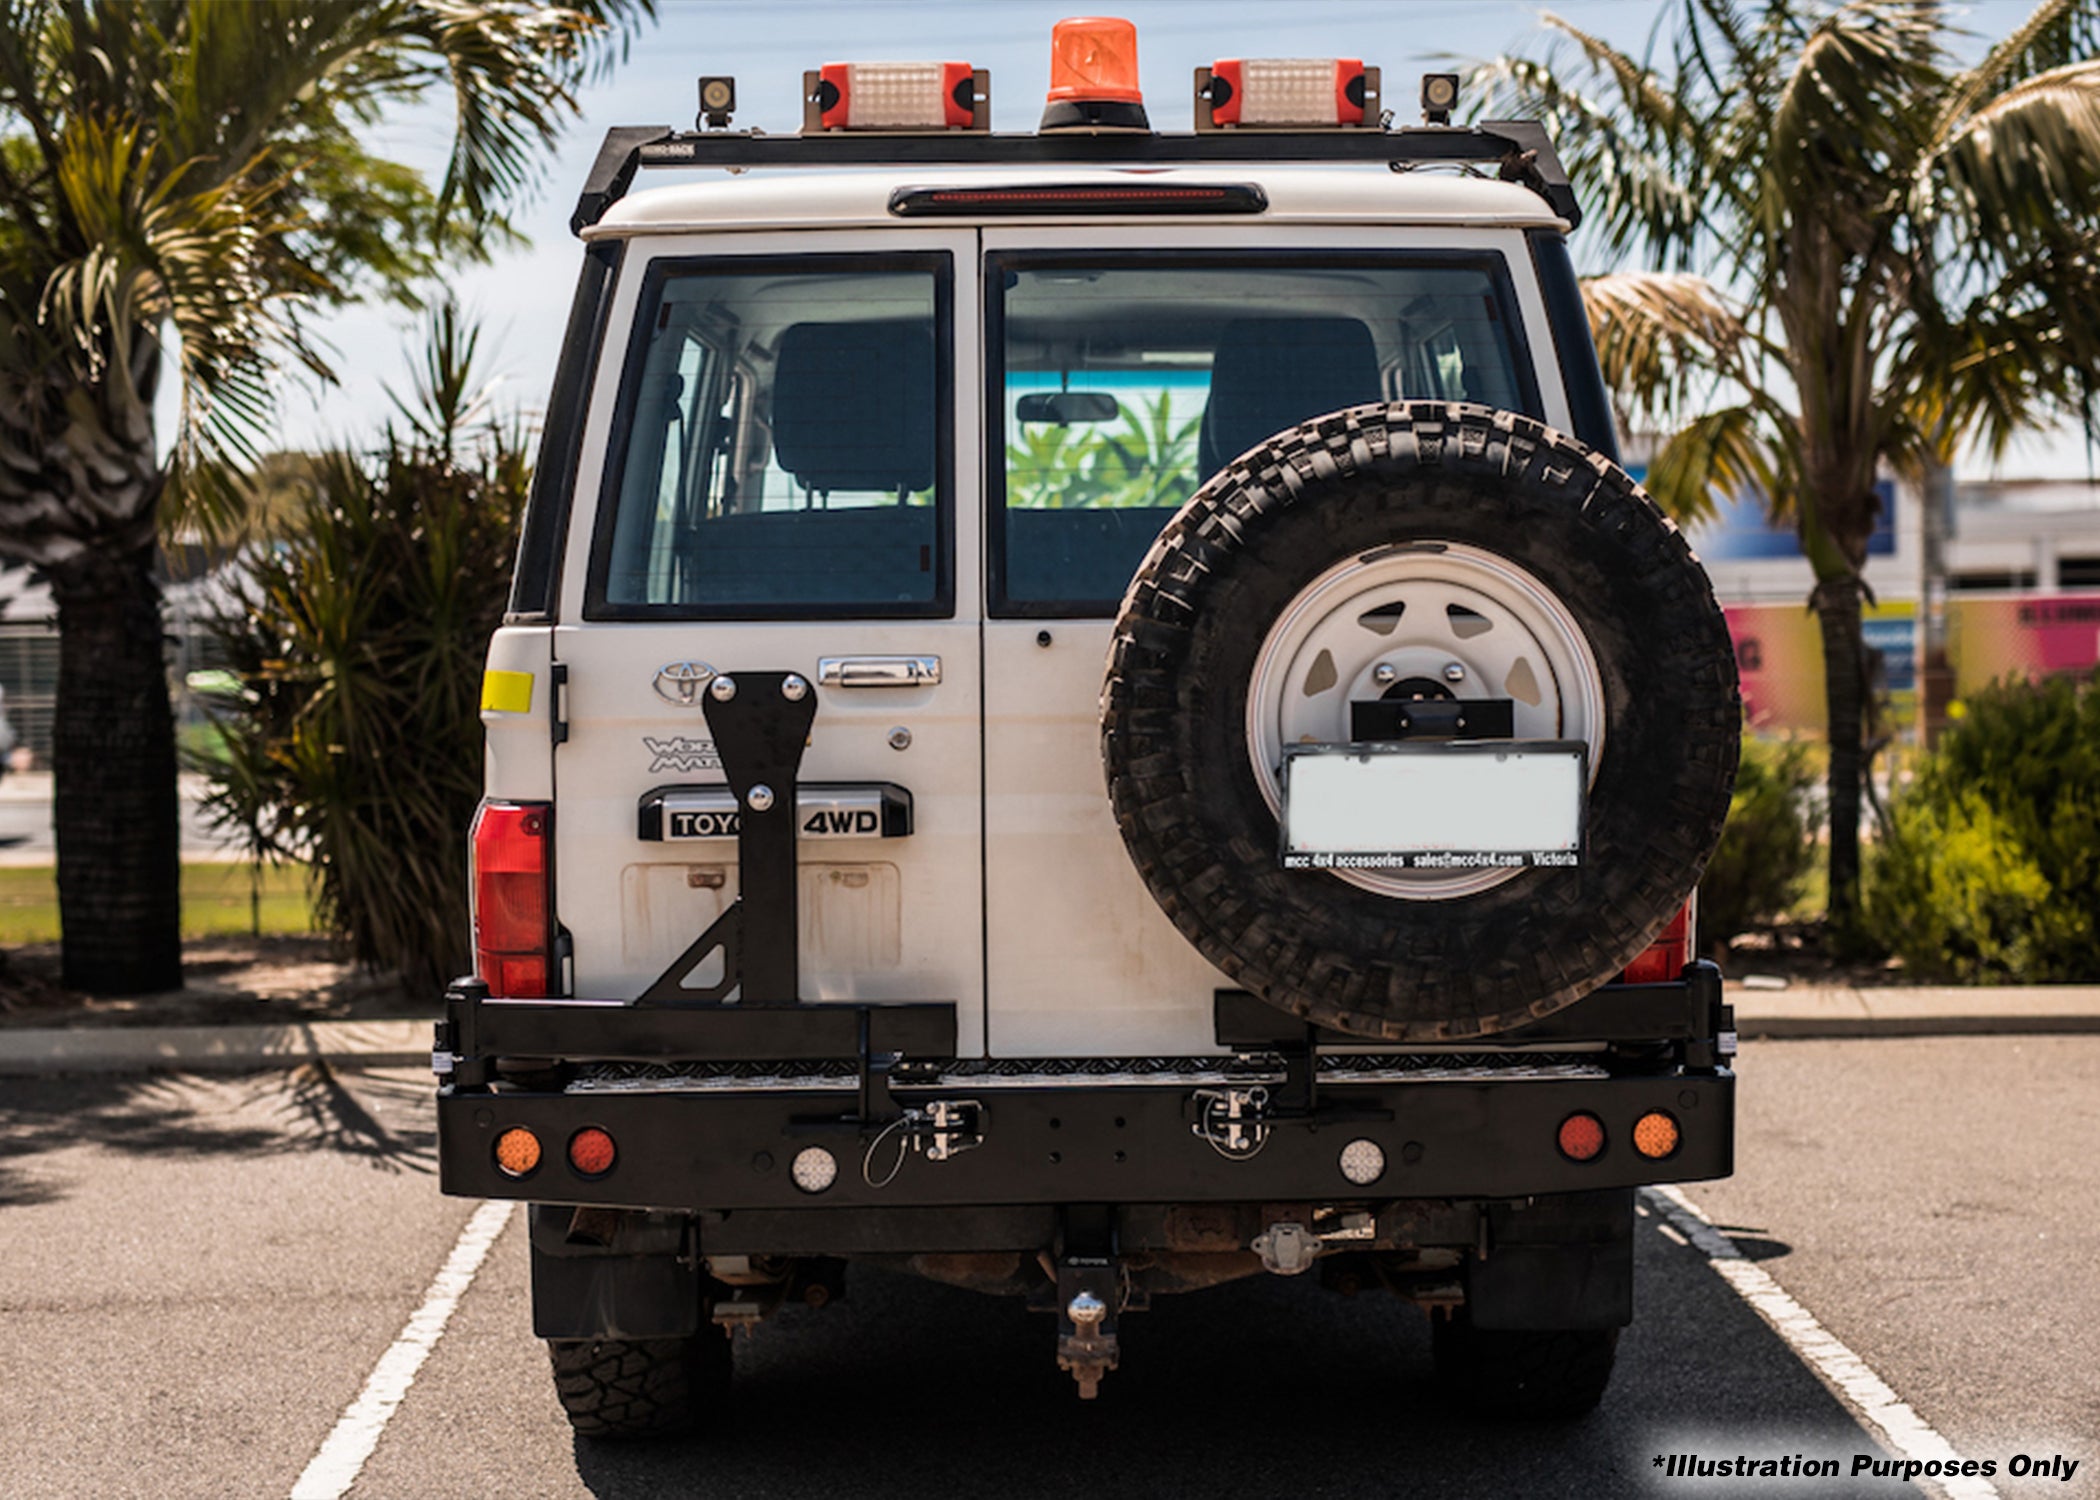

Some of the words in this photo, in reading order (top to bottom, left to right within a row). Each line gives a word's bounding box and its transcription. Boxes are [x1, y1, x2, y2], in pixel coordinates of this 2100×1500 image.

[642, 736, 717, 756] WOR
[648, 754, 722, 773] MAT
[676, 815, 741, 835] TOY
[803, 811, 878, 833] 4WD
[1284, 856, 1310, 867] mcc
[1311, 853, 1334, 867] 4x4
[1335, 852, 1404, 868] accessories
[1532, 851, 1578, 867] Victoria
